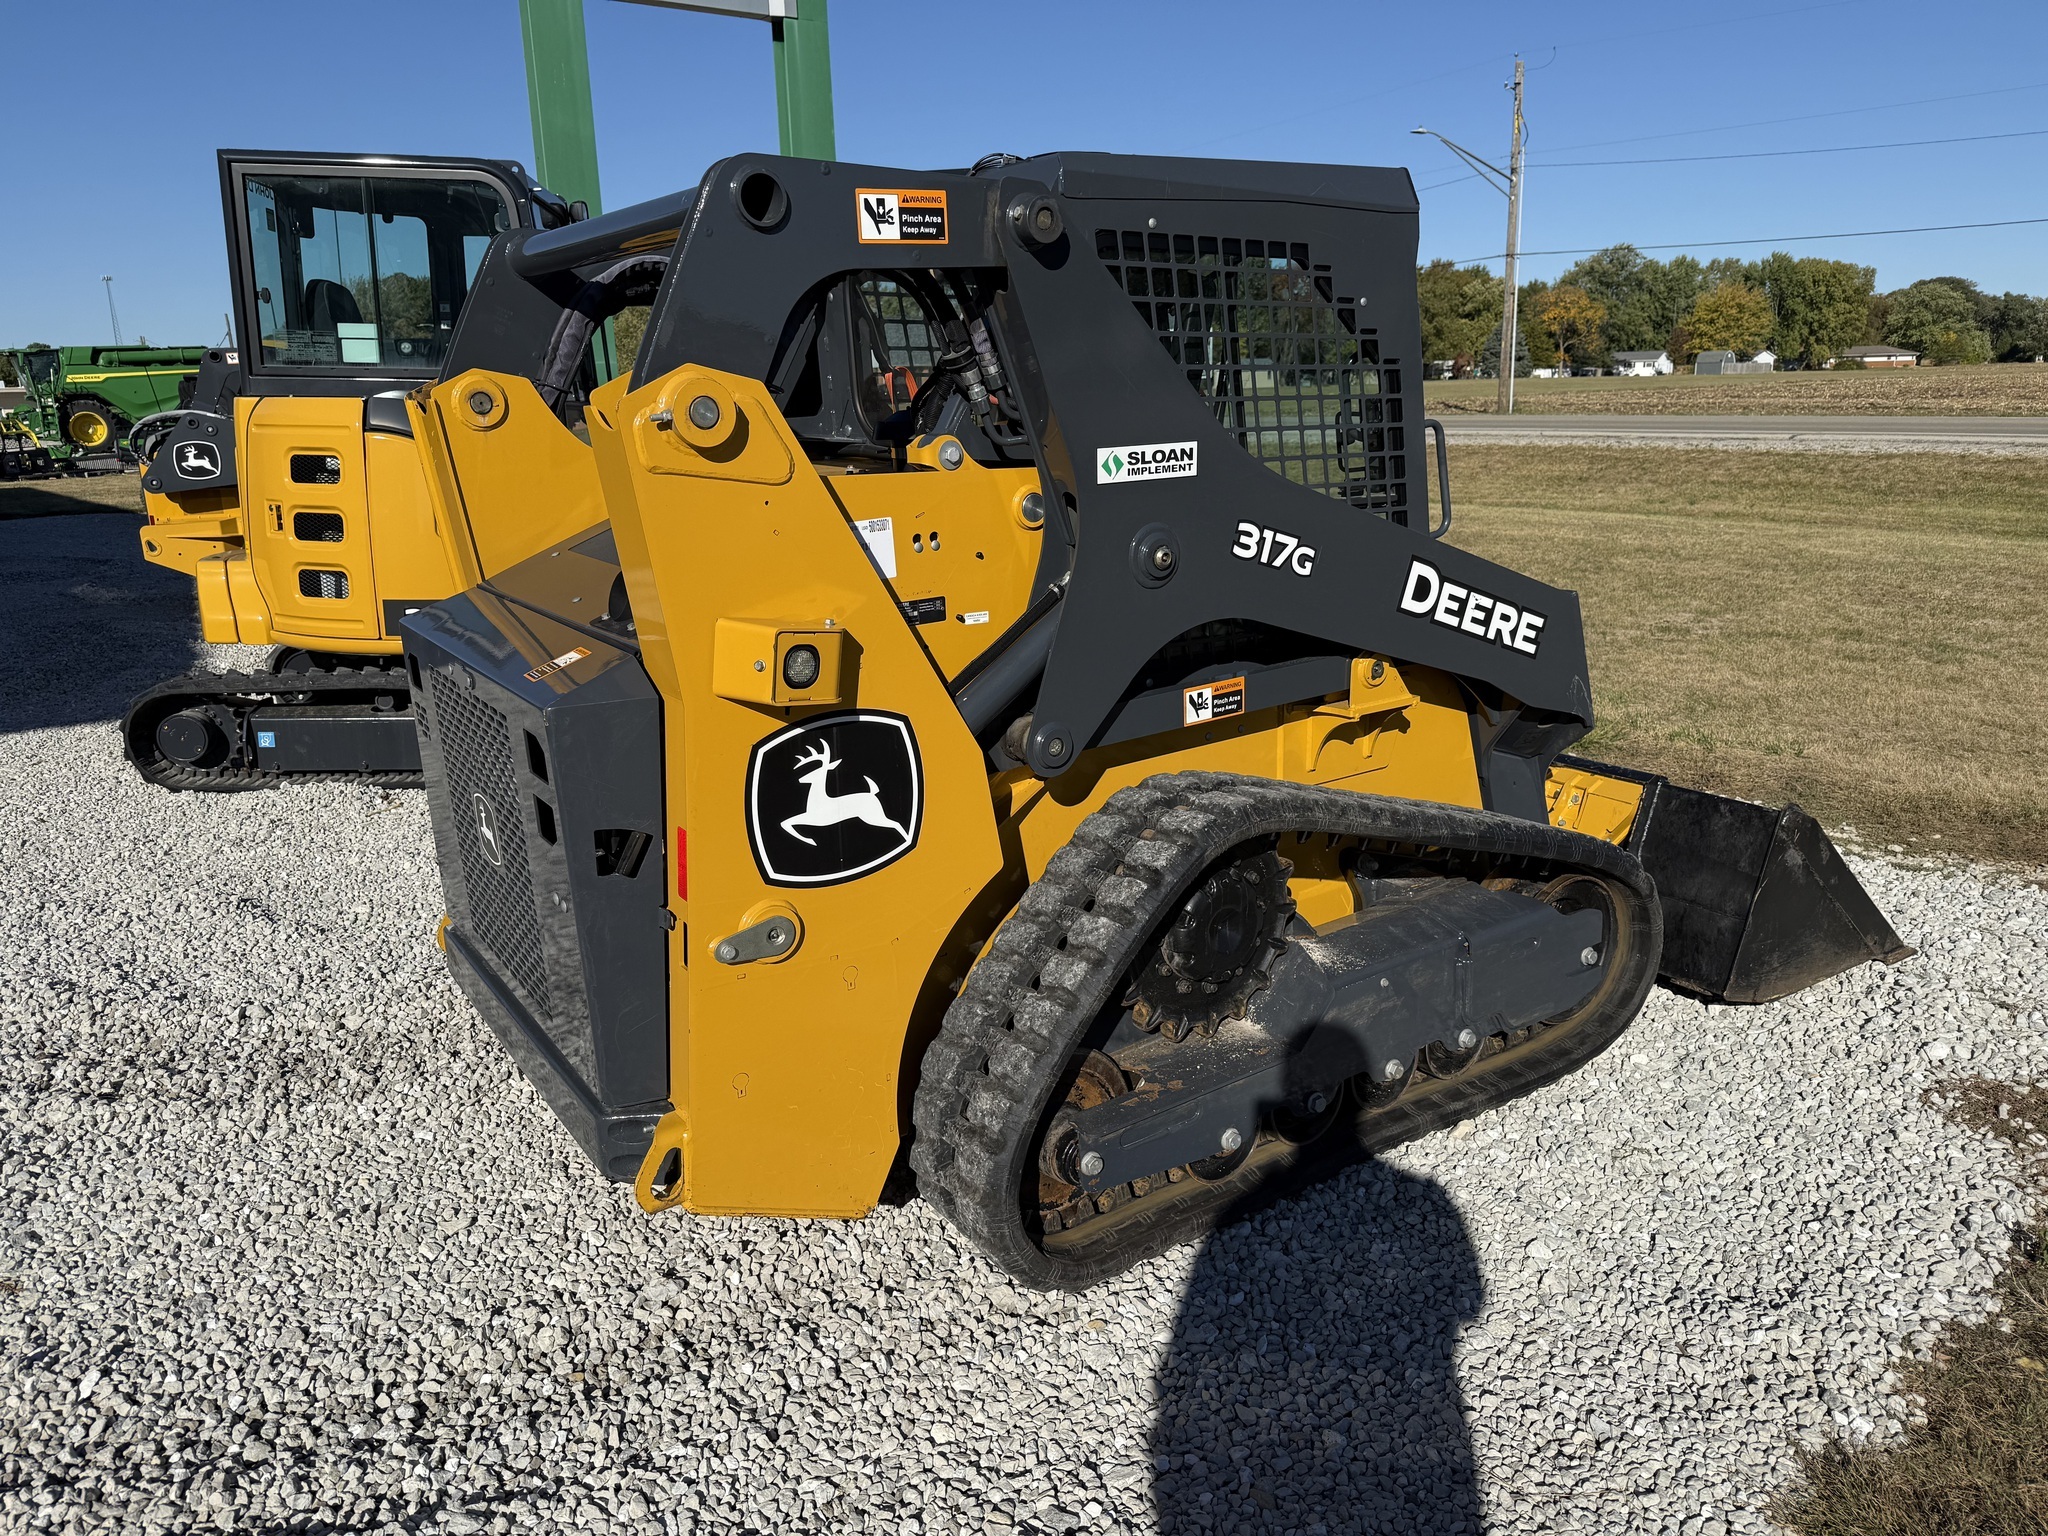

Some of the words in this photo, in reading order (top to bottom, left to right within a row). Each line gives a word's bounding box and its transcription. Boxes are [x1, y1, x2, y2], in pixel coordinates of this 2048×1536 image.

[909, 196, 942, 204] WARNING
[902, 214, 923, 223] Pinch
[924, 214, 942, 223] Area
[902, 226, 919, 235] Keep
[919, 226, 937, 235] Away
[1127, 447, 1194, 466] SLOAN
[1127, 463, 1194, 476] IMPLEMENT
[1232, 522, 1316, 576] 317G
[1400, 560, 1545, 655] DEERE
[1219, 681, 1242, 691] WARNING
[1213, 697, 1229, 706] Pinch
